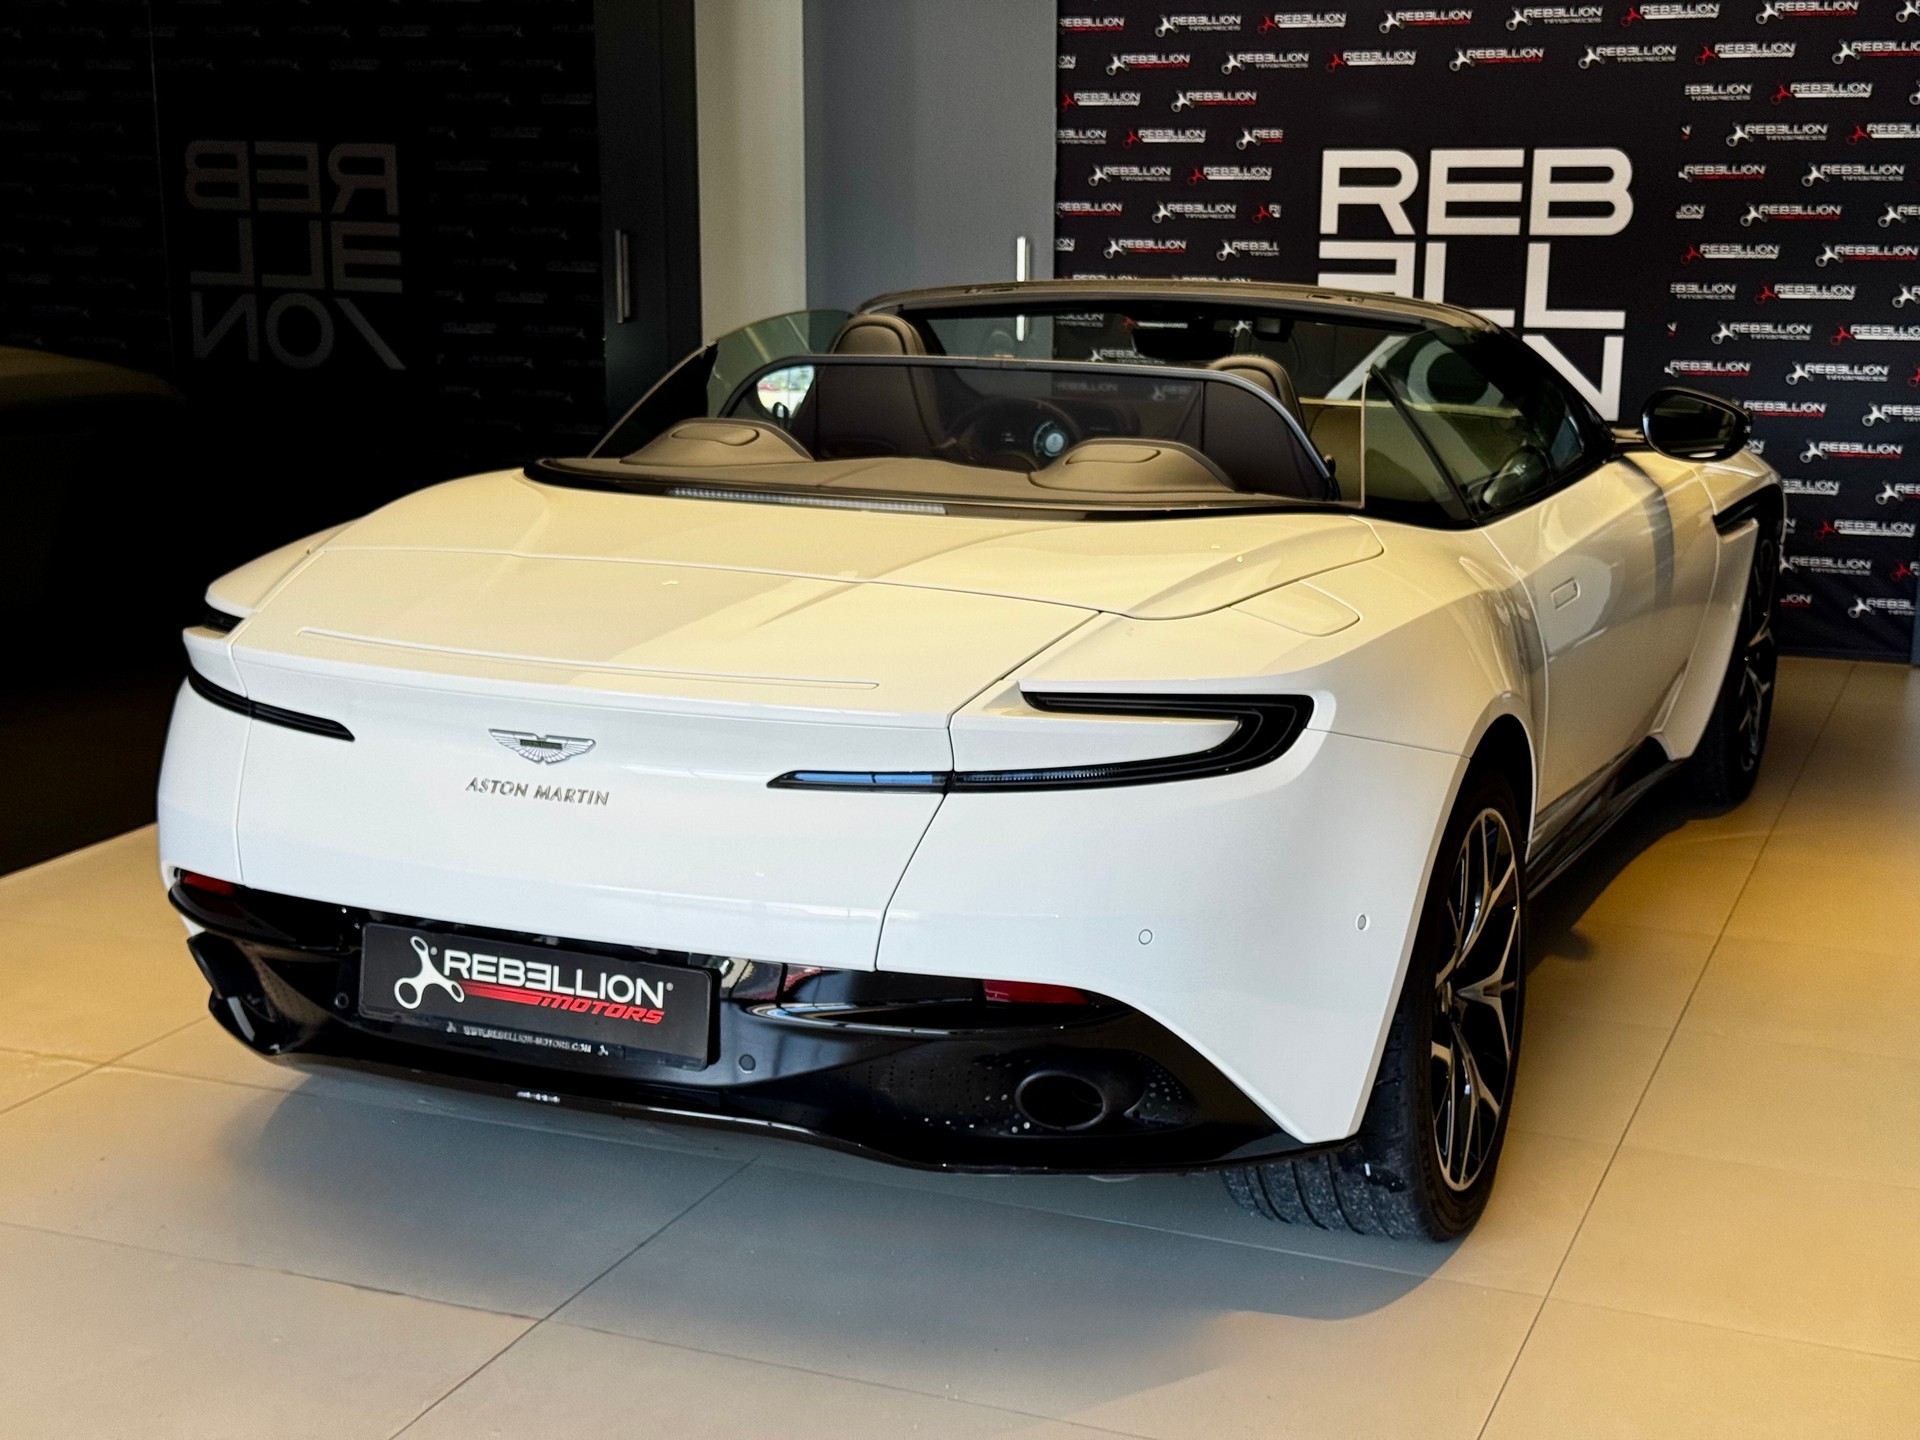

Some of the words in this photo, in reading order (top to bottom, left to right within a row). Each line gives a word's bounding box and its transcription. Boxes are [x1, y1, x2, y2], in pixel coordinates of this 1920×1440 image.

[1640, 4, 1720, 15] REBELLION
[1776, 1, 1859, 11] REBELLION
[1397, 10, 1472, 21] REBELLION
[1524, 6, 1602, 18] REBELLION
[1171, 15, 1241, 26] REBELLION
[1275, 12, 1347, 24] REBELLION
[1467, 48, 1544, 59] REBELLION
[1597, 45, 1677, 56] REBELLION
[1715, 42, 1796, 54] REBELLION
[1121, 54, 1190, 64] REBELLION
[1237, 53, 1309, 63] REBELLION
[1343, 50, 1417, 62] REBELLION
[1791, 83, 1873, 94] REBELLION
[1074, 92, 1141, 101] REBELLION
[1186, 92, 1257, 101] REBELLION
[1138, 130, 1206, 139] REBELLION
[1745, 124, 1828, 135] REBELLION
[1104, 167, 1171, 176] REBELLION
[1203, 167, 1272, 176] REBELLION
[1685, 164, 1766, 175] REBELLION
[1821, 164, 1905, 175] REBELLION
[1319, 148, 1635, 236] REB
[1167, 204, 1236, 213] REBELLION
[1760, 204, 1842, 215] REBELLION
[1118, 240, 1187, 249] REBELLION
[1701, 244, 1779, 255] REBELLION
[1835, 245, 1918, 256] REBELLION
[1774, 284, 1856, 295] REBELLION
[1730, 323, 1812, 334] REBELLION
[1805, 364, 1889, 375] REBELLION
[1744, 401, 1827, 413] REBELLION
[1819, 442, 1903, 454] REBELLION
[1834, 519, 1915, 532] REBELLION
[465, 777, 529, 797] ASTON
[533, 785, 610, 806] MARTIN
[443, 949, 664, 1009] REBELLION
[538, 995, 665, 1025] MOTORS
